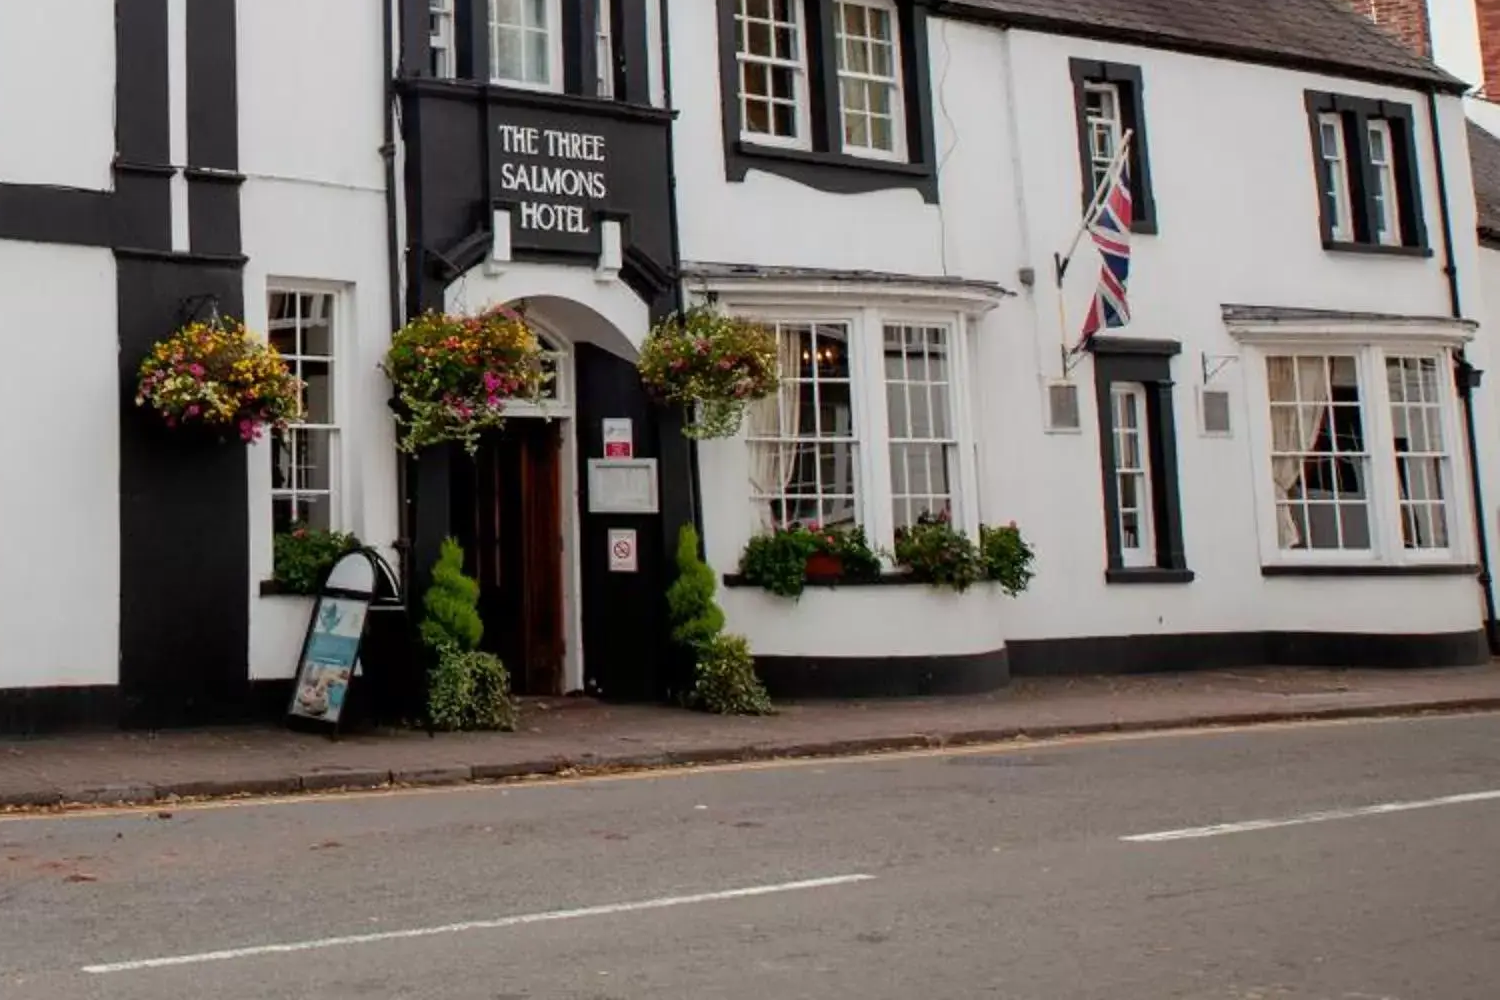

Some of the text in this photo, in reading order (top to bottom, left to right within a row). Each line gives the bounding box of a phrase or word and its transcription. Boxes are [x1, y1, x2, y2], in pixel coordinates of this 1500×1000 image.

[499, 125, 605, 161] THE THREE
[501, 162, 606, 198] SALMONS
[521, 201, 589, 233] HOTEL
